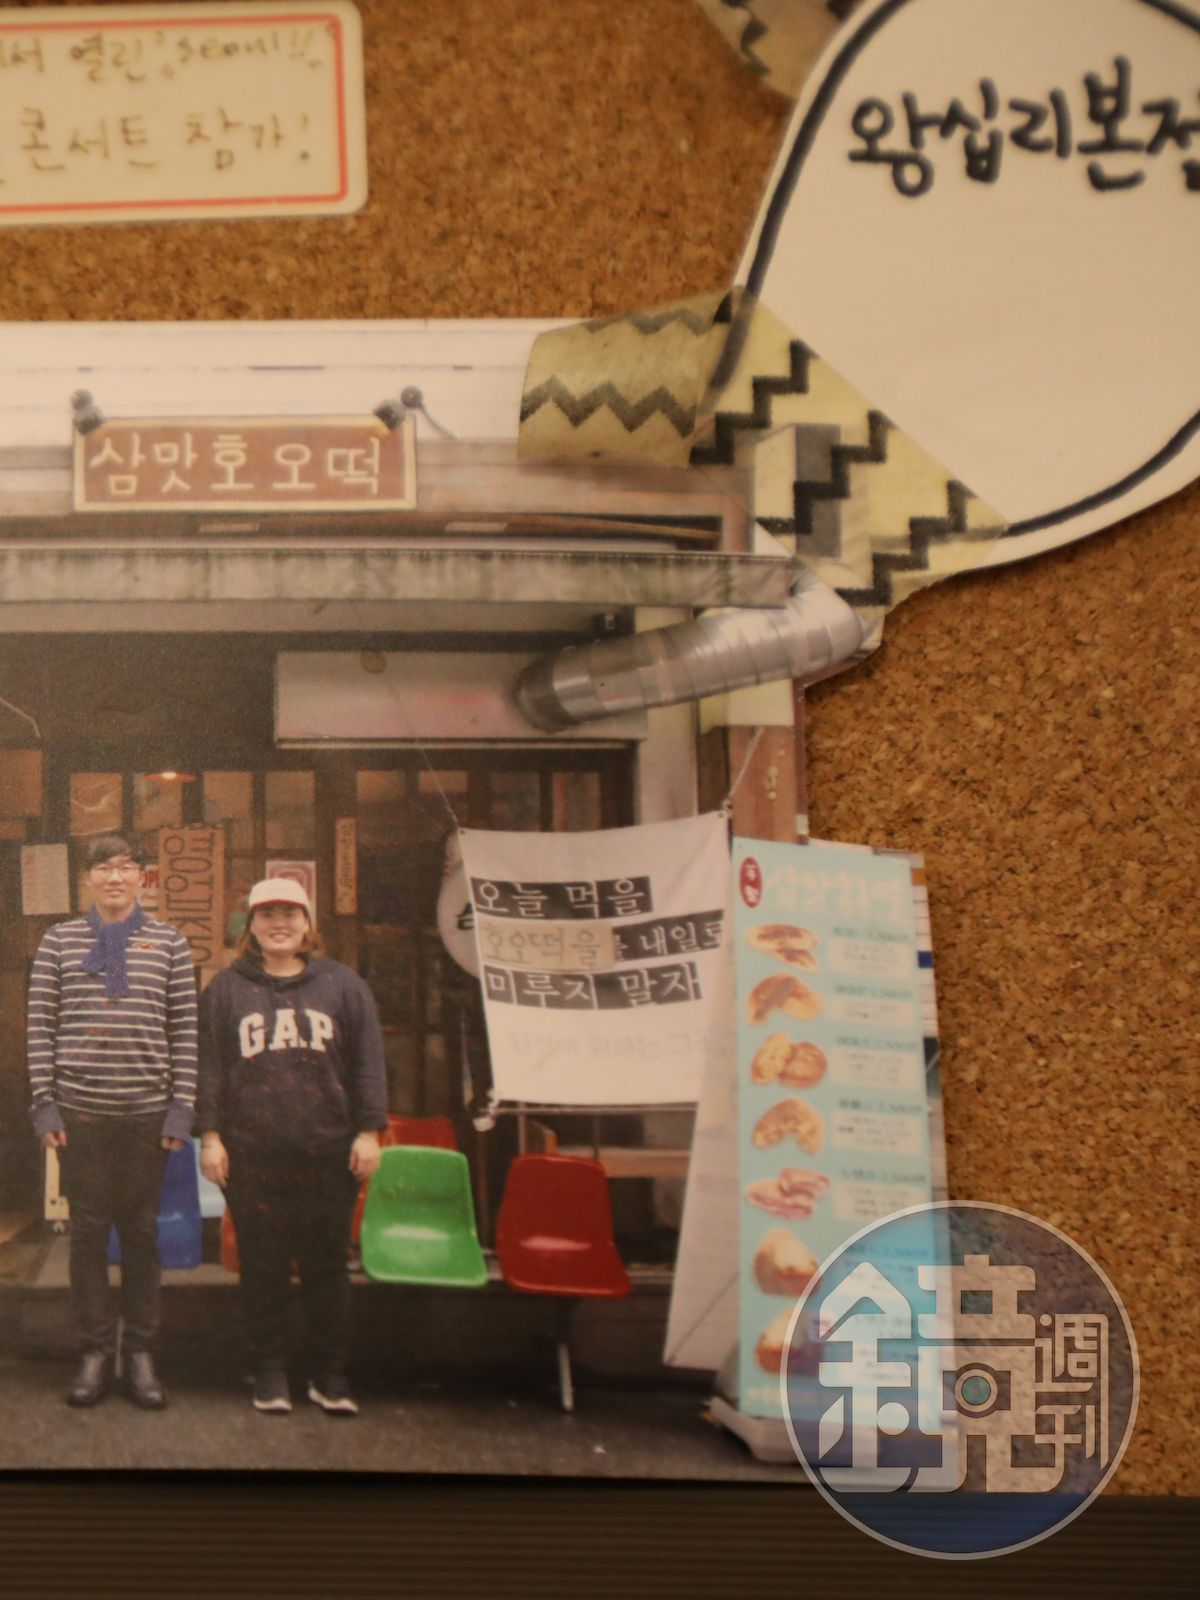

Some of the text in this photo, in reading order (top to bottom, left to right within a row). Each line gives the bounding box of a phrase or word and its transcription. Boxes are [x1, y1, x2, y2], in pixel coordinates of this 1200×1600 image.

[88, 431, 381, 496] 삼맛호오떡
[475, 877, 646, 919] 오늘 먹을
[486, 962, 701, 1010] 미루지 말자
[238, 1008, 334, 1059] GAP
